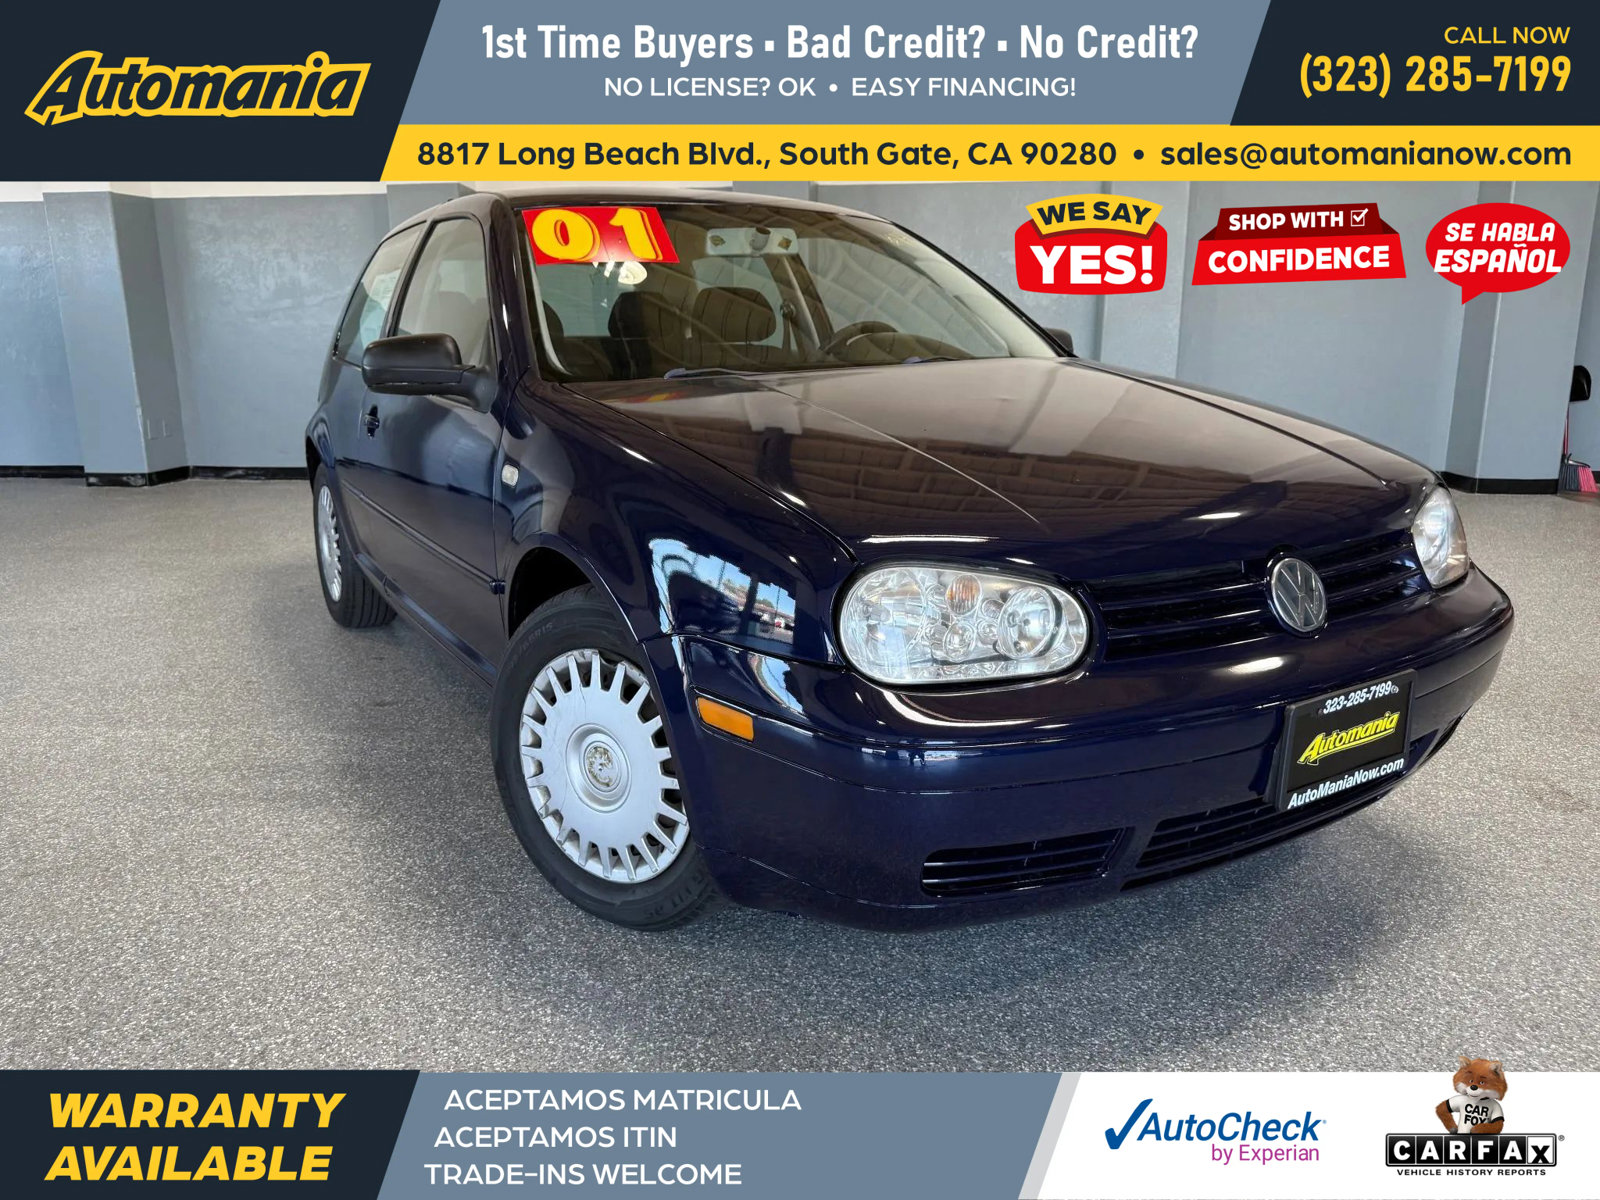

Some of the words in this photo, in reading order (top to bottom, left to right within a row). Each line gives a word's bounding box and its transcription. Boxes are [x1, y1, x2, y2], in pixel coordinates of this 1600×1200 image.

[532, 207, 663, 261] 01
[1323, 680, 1392, 714] 323-285-7199
[1297, 711, 1400, 766] Automania
[1287, 758, 1405, 809] AutoManiaNow.com
